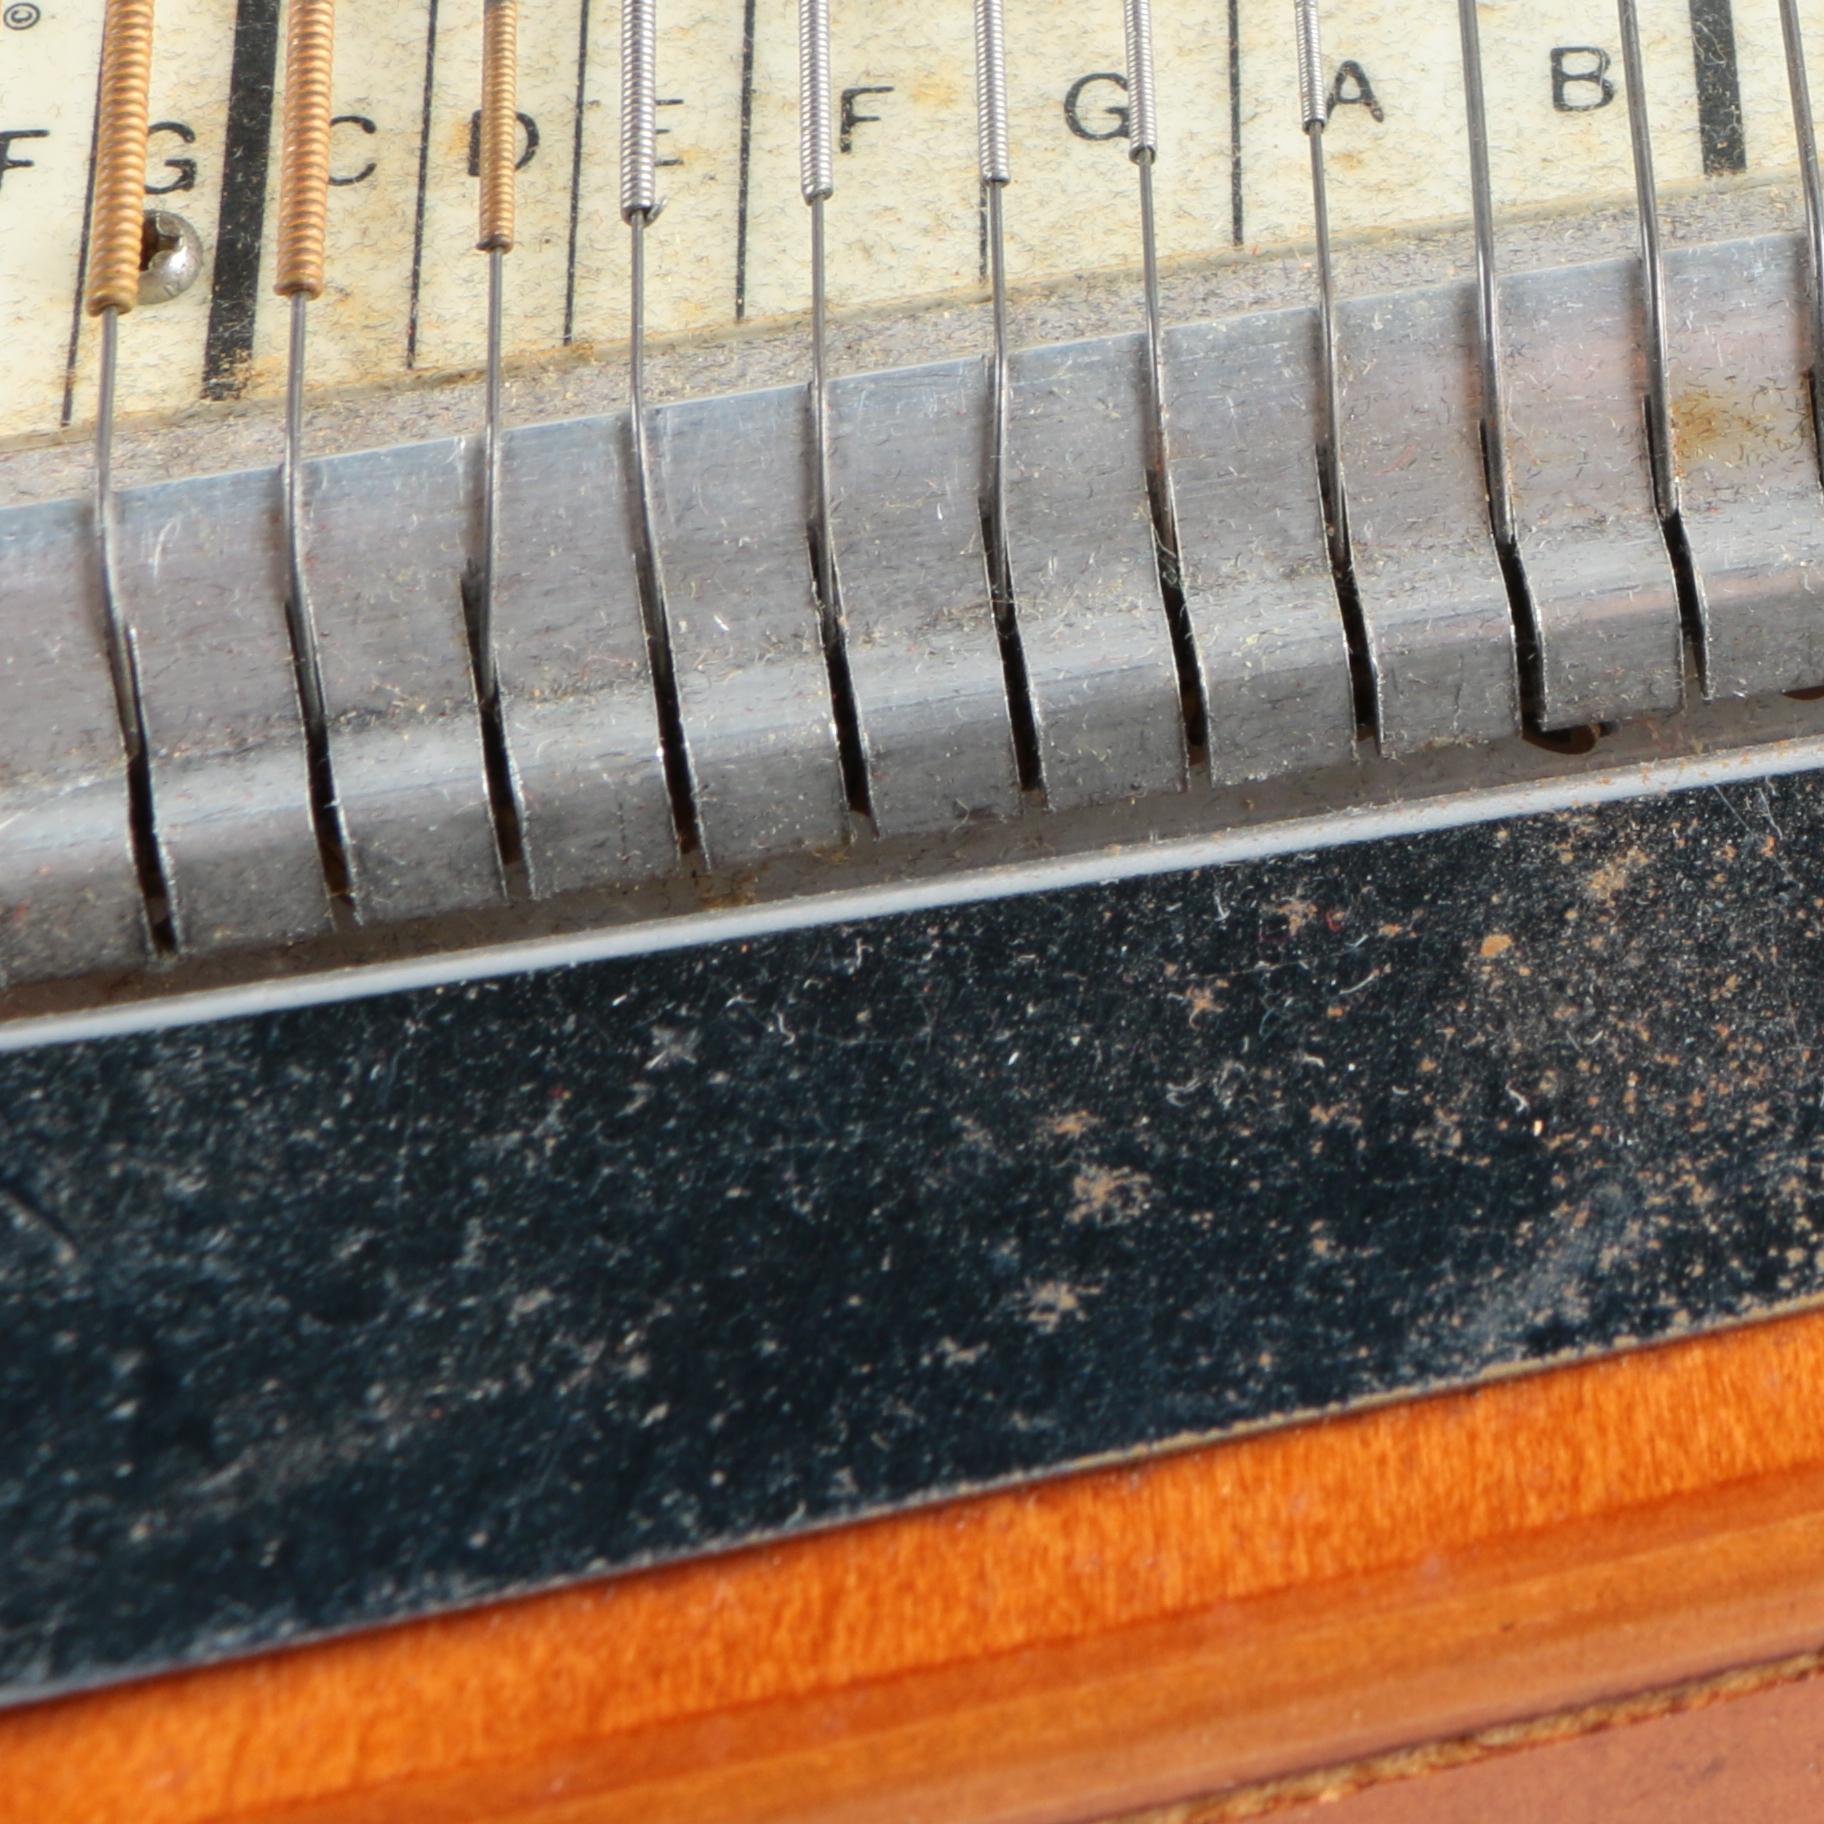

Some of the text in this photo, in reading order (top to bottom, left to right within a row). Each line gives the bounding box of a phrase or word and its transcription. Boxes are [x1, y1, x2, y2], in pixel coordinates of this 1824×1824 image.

[841, 86, 893, 152] F
[1065, 72, 1130, 140] G
[1326, 61, 1383, 123] A
[1551, 47, 1614, 111] B
